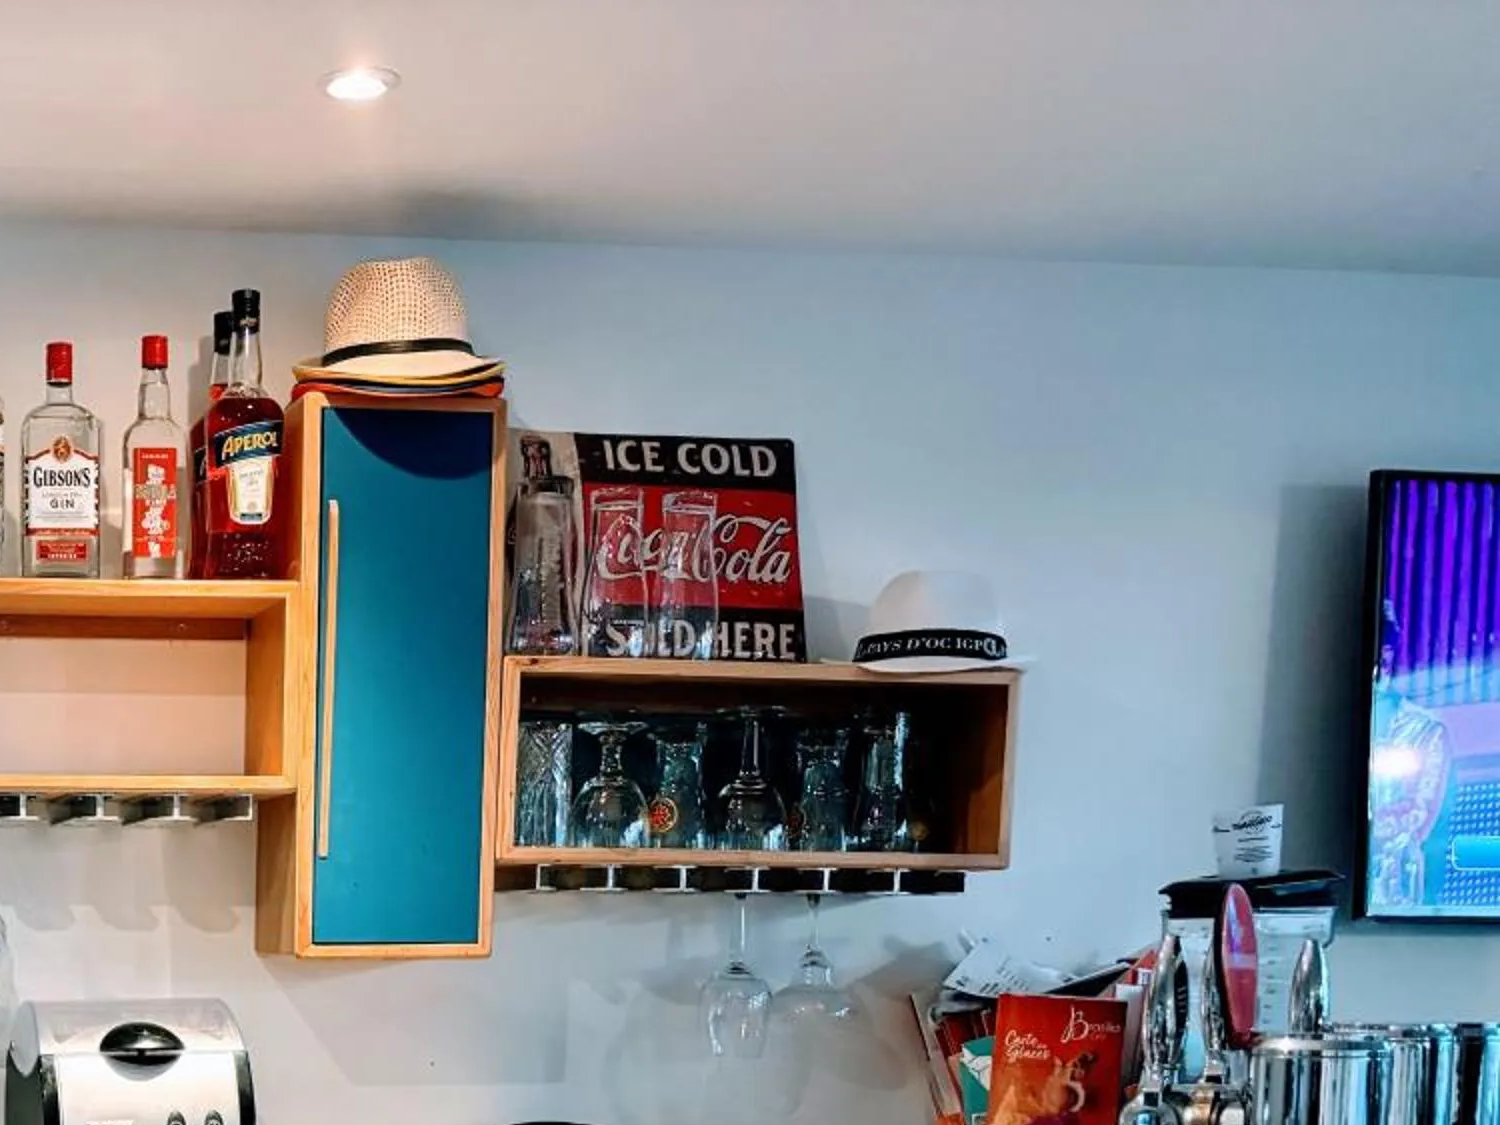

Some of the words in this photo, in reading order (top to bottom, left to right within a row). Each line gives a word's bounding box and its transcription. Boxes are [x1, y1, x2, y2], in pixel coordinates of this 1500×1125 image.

[221, 431, 278, 461] APEROL
[602, 439, 664, 473] ICE
[676, 442, 777, 477] COLD
[33, 466, 91, 488] GIBSON'S
[50, 499, 75, 509] GIN
[713, 621, 796, 660] HERE
